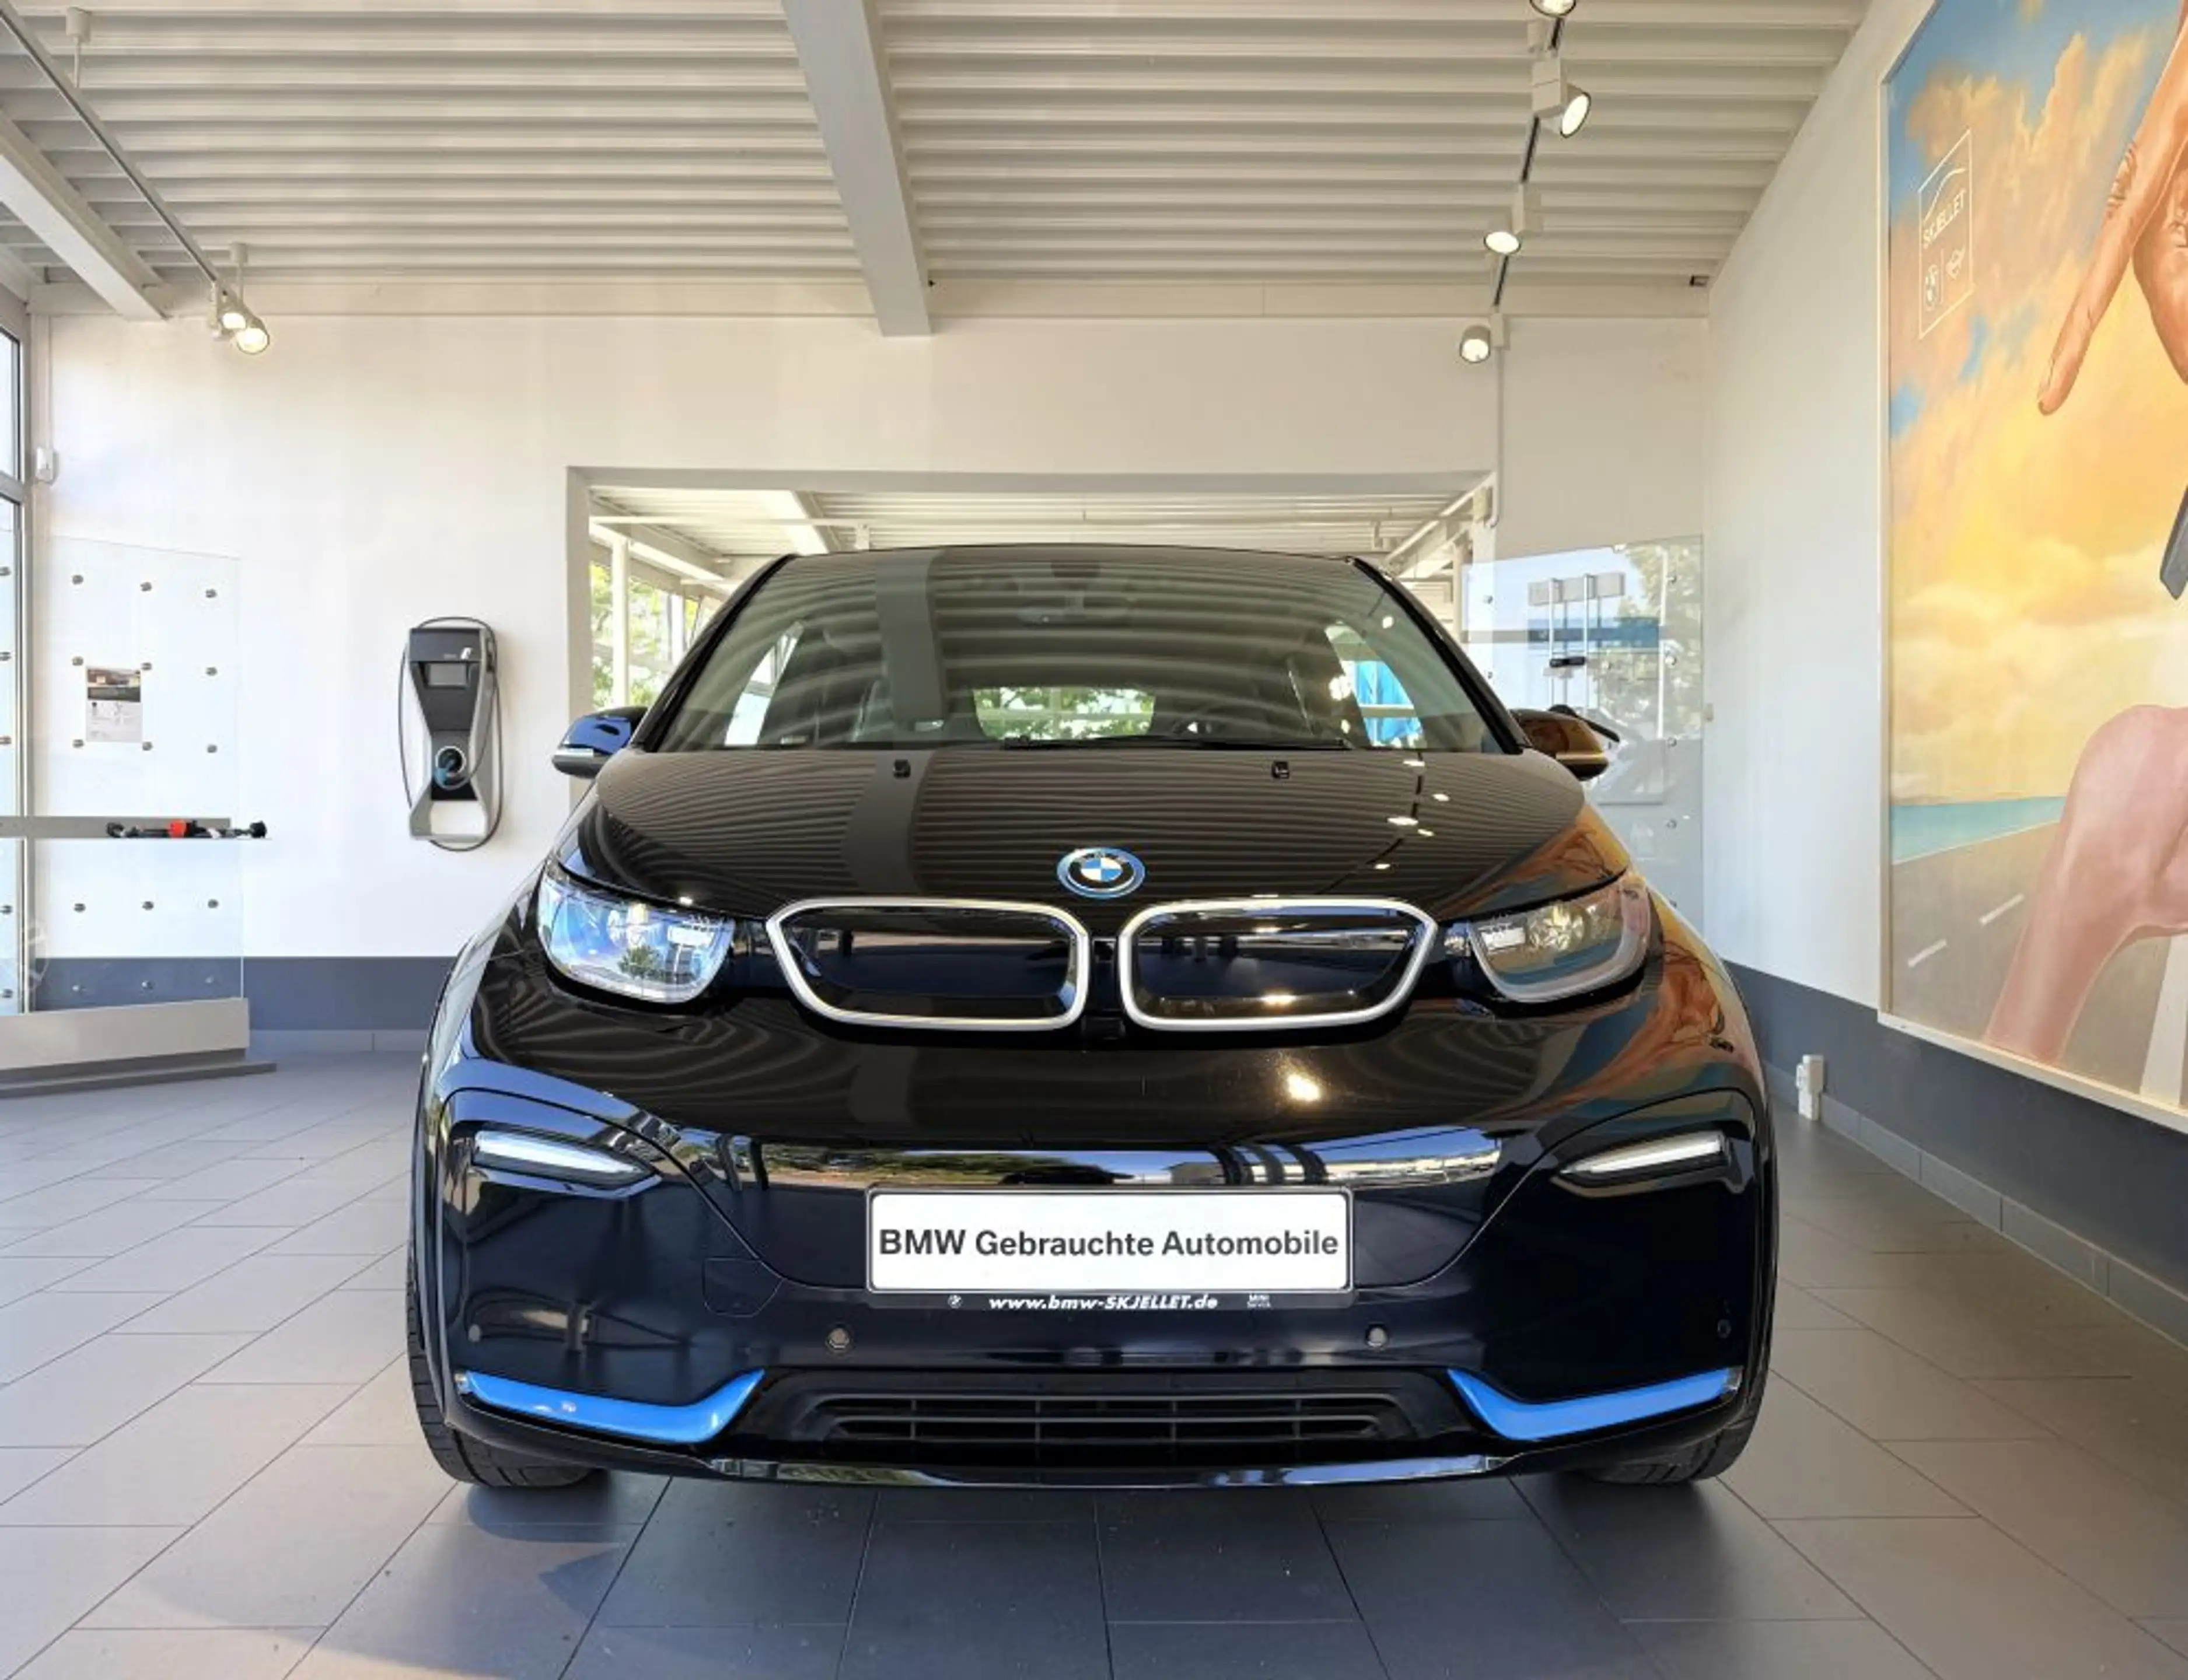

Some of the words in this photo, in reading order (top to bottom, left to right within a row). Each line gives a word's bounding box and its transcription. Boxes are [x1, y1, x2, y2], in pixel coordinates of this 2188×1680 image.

[880, 1228, 966, 1255] BMW
[975, 1230, 1154, 1256] Gebrauchte
[1161, 1230, 1338, 1255] Automobile
[989, 1294, 1218, 1310] www.bmw-SKJELLET.de
